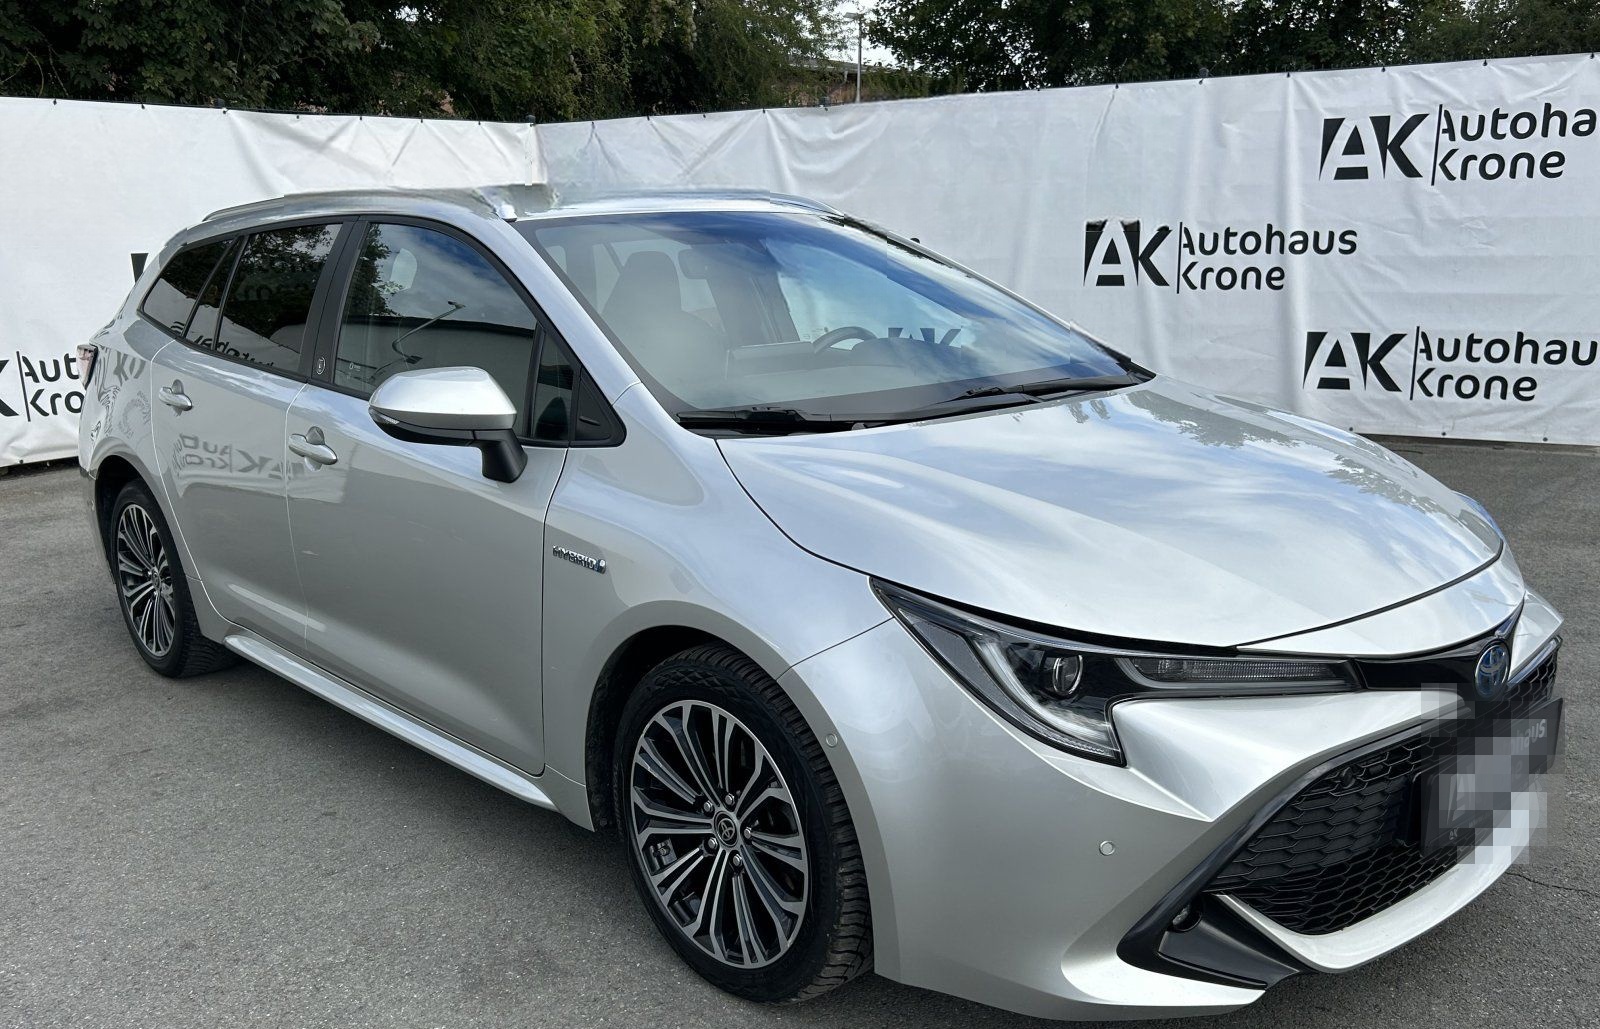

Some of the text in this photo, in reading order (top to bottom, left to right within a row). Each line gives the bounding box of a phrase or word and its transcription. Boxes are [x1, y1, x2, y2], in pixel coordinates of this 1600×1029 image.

[1441, 102, 1597, 142] Autoha
[1320, 113, 1430, 181] AK
[1438, 149, 1566, 182] Krone
[1083, 218, 1173, 287] AK
[1182, 223, 1358, 256] Autohaus
[1181, 261, 1286, 291] Krone
[1303, 331, 1408, 393] AK
[1419, 331, 1599, 367] Autohau
[1416, 367, 1538, 402] Krone
[552, 544, 597, 571] HYBRID
